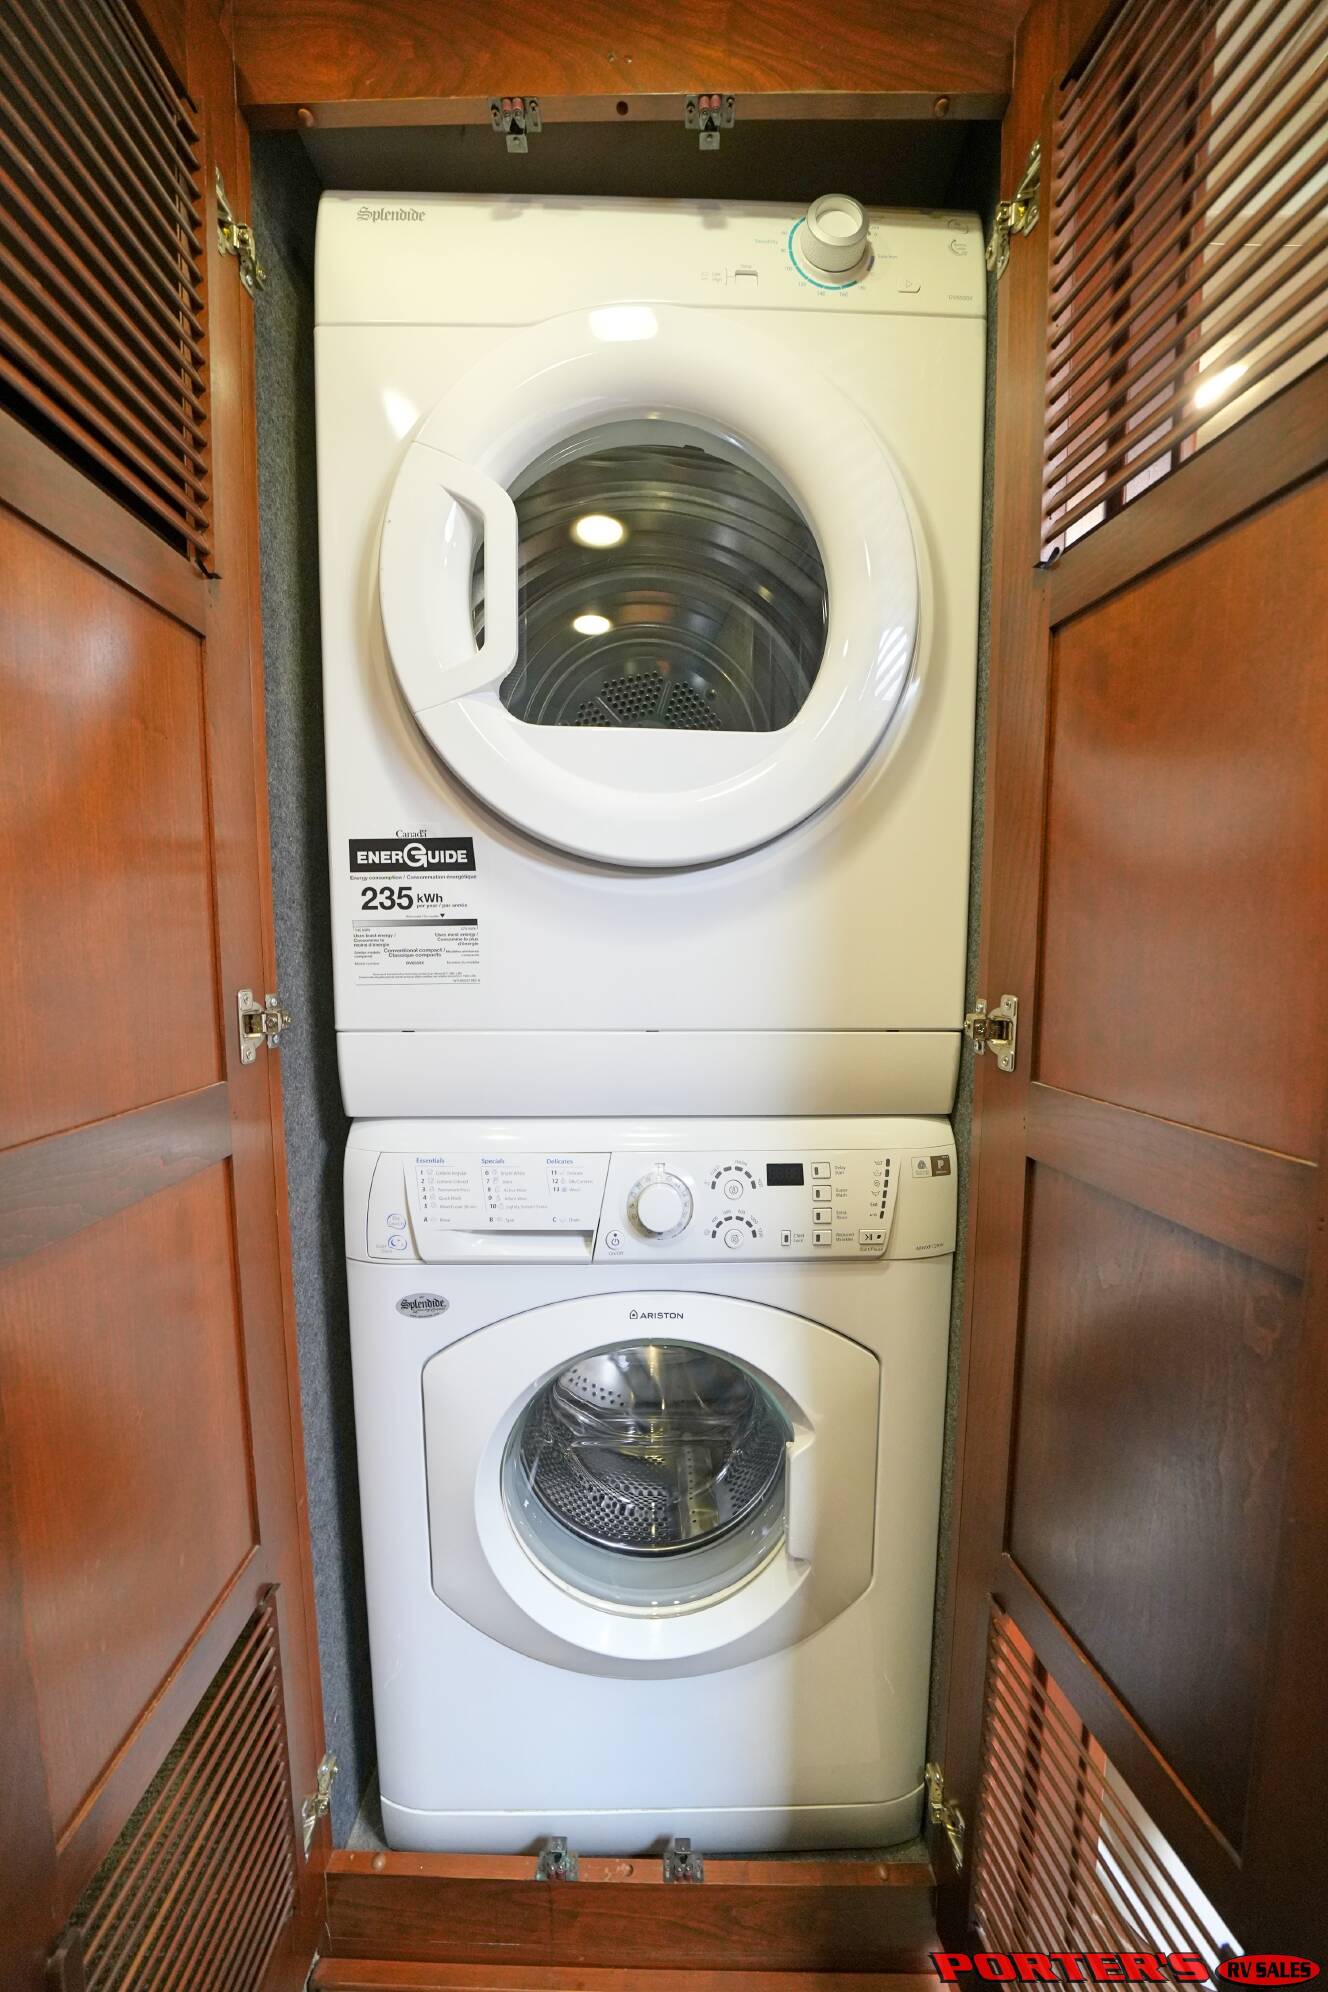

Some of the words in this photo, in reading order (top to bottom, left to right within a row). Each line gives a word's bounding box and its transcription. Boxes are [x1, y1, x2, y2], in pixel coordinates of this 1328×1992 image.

[356, 206, 426, 222] Splendide
[356, 842, 468, 868] ENERGUIDE
[361, 886, 414, 910] 235
[417, 893, 443, 903] kWh
[400, 1298, 445, 1310] Splendide
